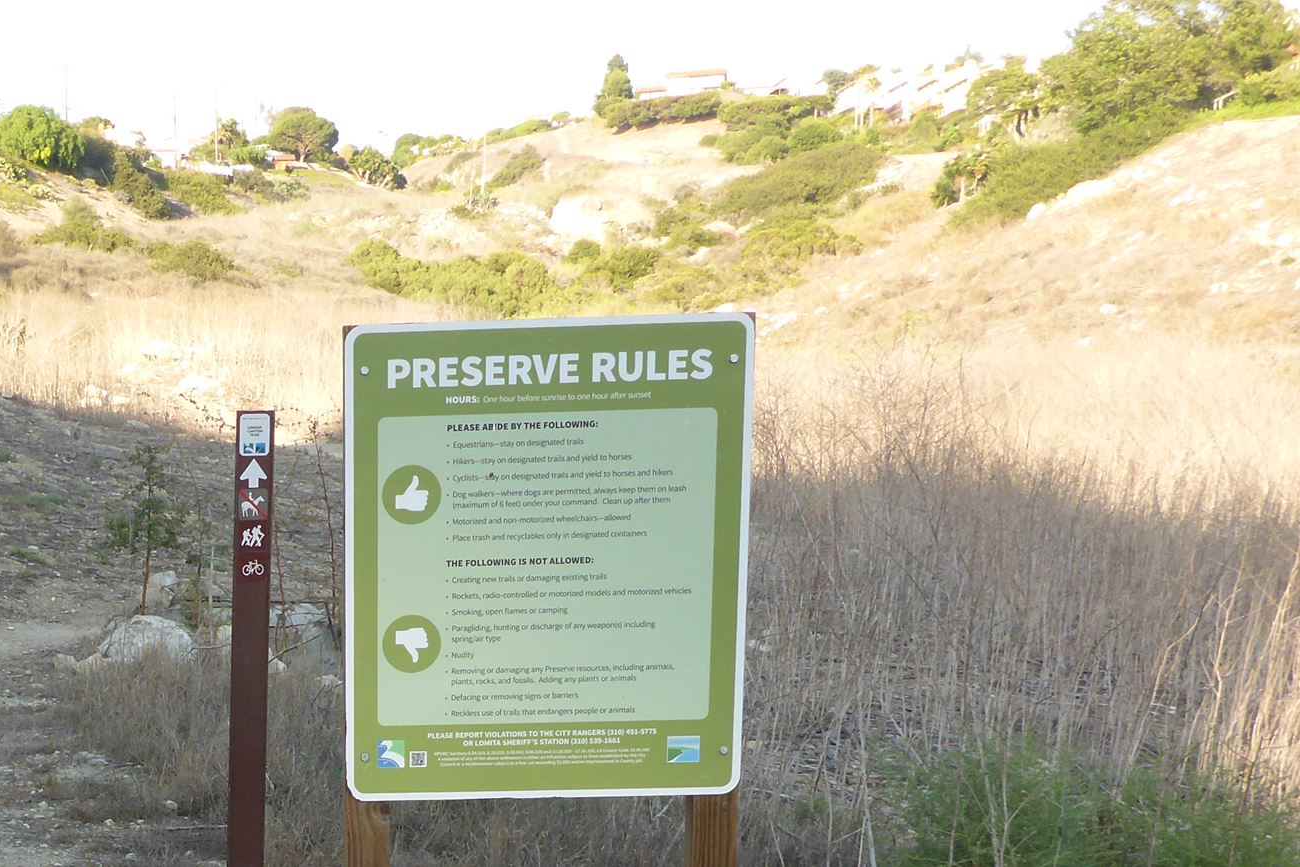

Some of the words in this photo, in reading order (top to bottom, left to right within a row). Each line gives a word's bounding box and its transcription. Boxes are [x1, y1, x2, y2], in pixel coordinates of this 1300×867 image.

[387, 353, 579, 389] PRESERVE
[592, 348, 713, 383] RULES
[445, 395, 480, 404] HOURS:
[517, 394, 540, 402] before
[447, 424, 480, 432] PLEASE
[511, 422, 522, 430] BY
[543, 420, 599, 429] FOLLOWING:
[526, 438, 565, 448] designated
[507, 456, 546, 465] designated
[566, 454, 580, 462] and
[581, 454, 598, 463] yield
[608, 453, 633, 461] horses
[511, 472, 550, 481] designated
[585, 470, 602, 479] yield
[452, 491, 467, 500] Dog
[524, 489, 541, 498] dogs
[555, 487, 592, 496] permitted,
[593, 487, 618, 495] always
[618, 486, 636, 494] keep
[491, 500, 499, 508] of
[499, 500, 504, 508] 6
[522, 499, 544, 507] under
[544, 500, 561, 508] your
[623, 498, 633, 506] up
[634, 496, 651, 504] after
[452, 517, 487, 525] Motorized
[491, 533, 505, 541] and
[506, 532, 545, 542] recyclables
[546, 532, 562, 541] only
[571, 531, 610, 540] designated
[465, 558, 517, 567] FOLLOWING
[529, 557, 548, 565] NOT
[452, 577, 481, 585] Creating
[498, 575, 516, 583] trails
[525, 575, 561, 583] damaging
[561, 573, 589, 582] existing
[452, 592, 481, 600] Rockets,
[452, 609, 484, 617] Smoking,
[538, 607, 568, 615] camping
[451, 624, 492, 633] Paragliding,
[493, 624, 521, 632] hunting
[530, 623, 564, 631] discharge
[564, 622, 572, 630] of
[624, 621, 656, 629] including
[485, 635, 502, 643] type
[451, 652, 475, 660] Nudity
[451, 666, 486, 676] Removing
[486, 666, 494, 674] or
[495, 667, 530, 675] damaging
[612, 664, 645, 672] including
[451, 678, 475, 686] plants,
[475, 677, 497, 685] rocks,
[538, 676, 563, 684] Adding
[578, 675, 600, 684] plants
[609, 674, 637, 682] animals
[451, 693, 481, 702] Defacing
[524, 693, 542, 701] signs
[494, 708, 502, 716] of
[503, 708, 521, 716] trails
[537, 708, 573, 716] endangers
[574, 707, 599, 716] people
[608, 706, 636, 714] animals
